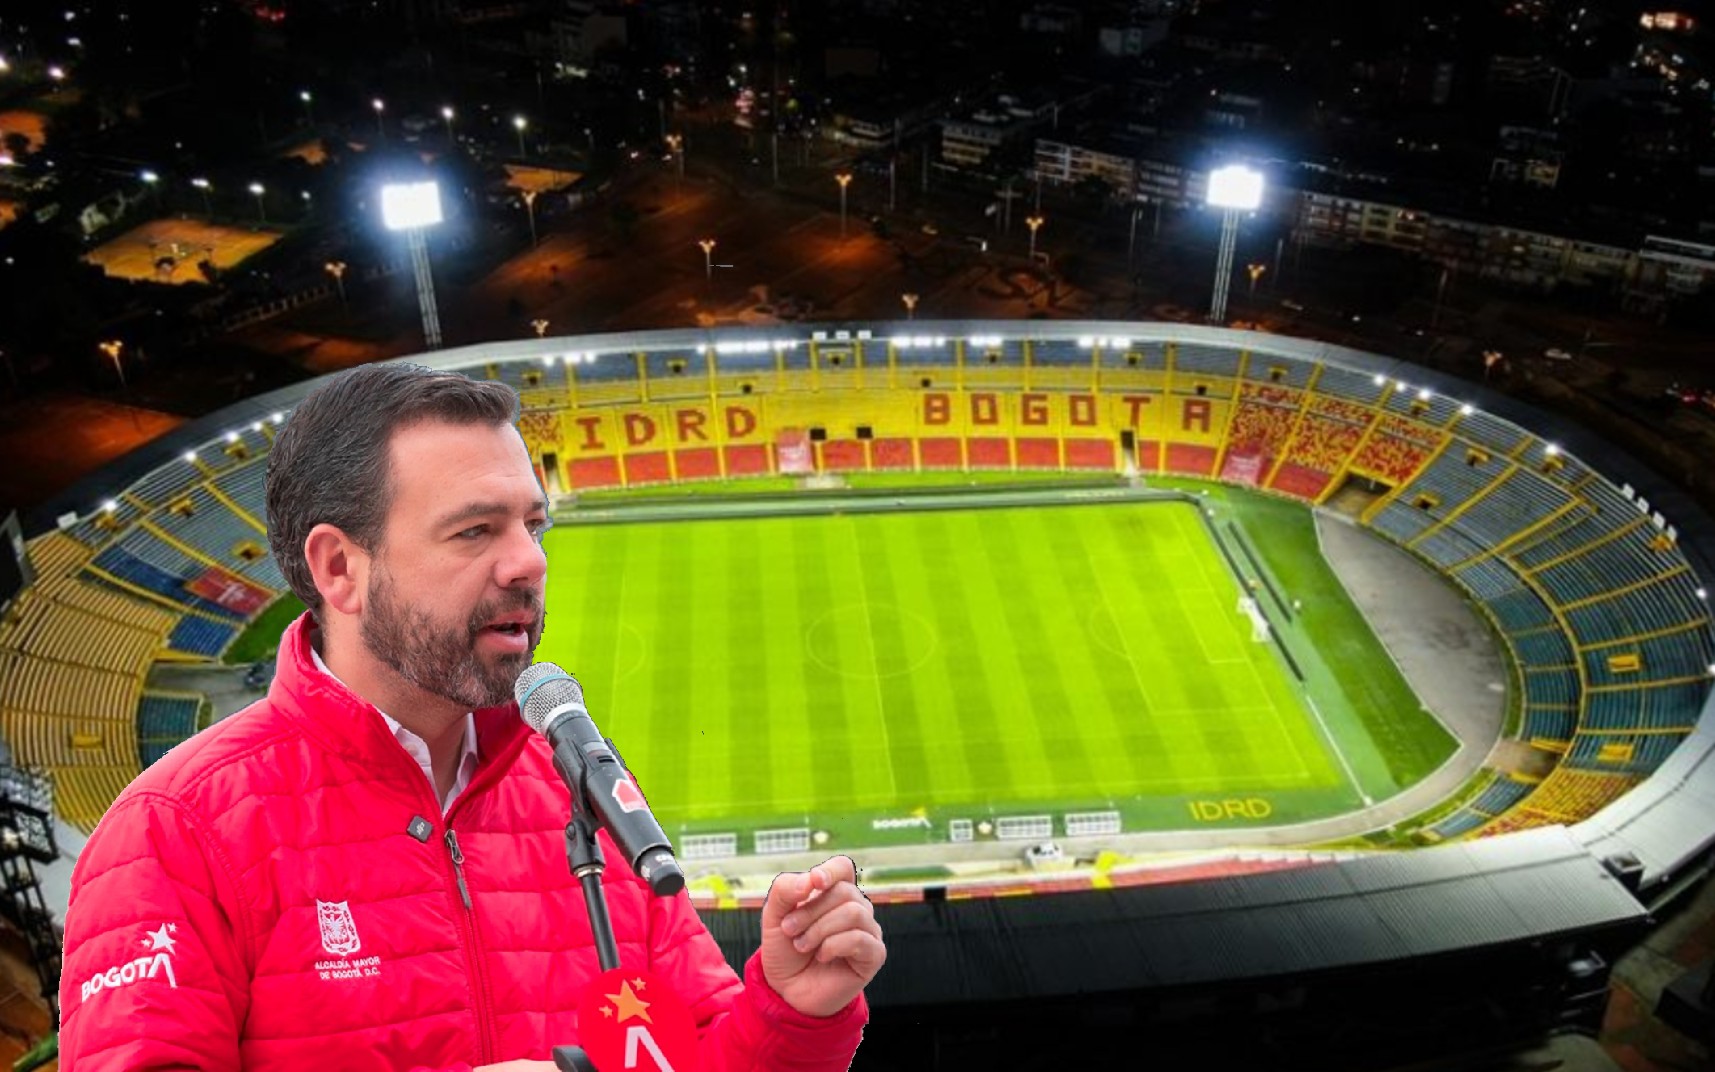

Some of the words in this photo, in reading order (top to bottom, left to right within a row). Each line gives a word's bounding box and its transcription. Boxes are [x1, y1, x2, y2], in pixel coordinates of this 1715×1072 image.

[576, 406, 757, 450] IDRD
[924, 393, 1211, 433] BOGOTA
[1188, 799, 1272, 822] IDRD
[352, 956, 380, 968] MAYOR
[320, 971, 331, 980] DE
[364, 967, 381, 977] D.C.
